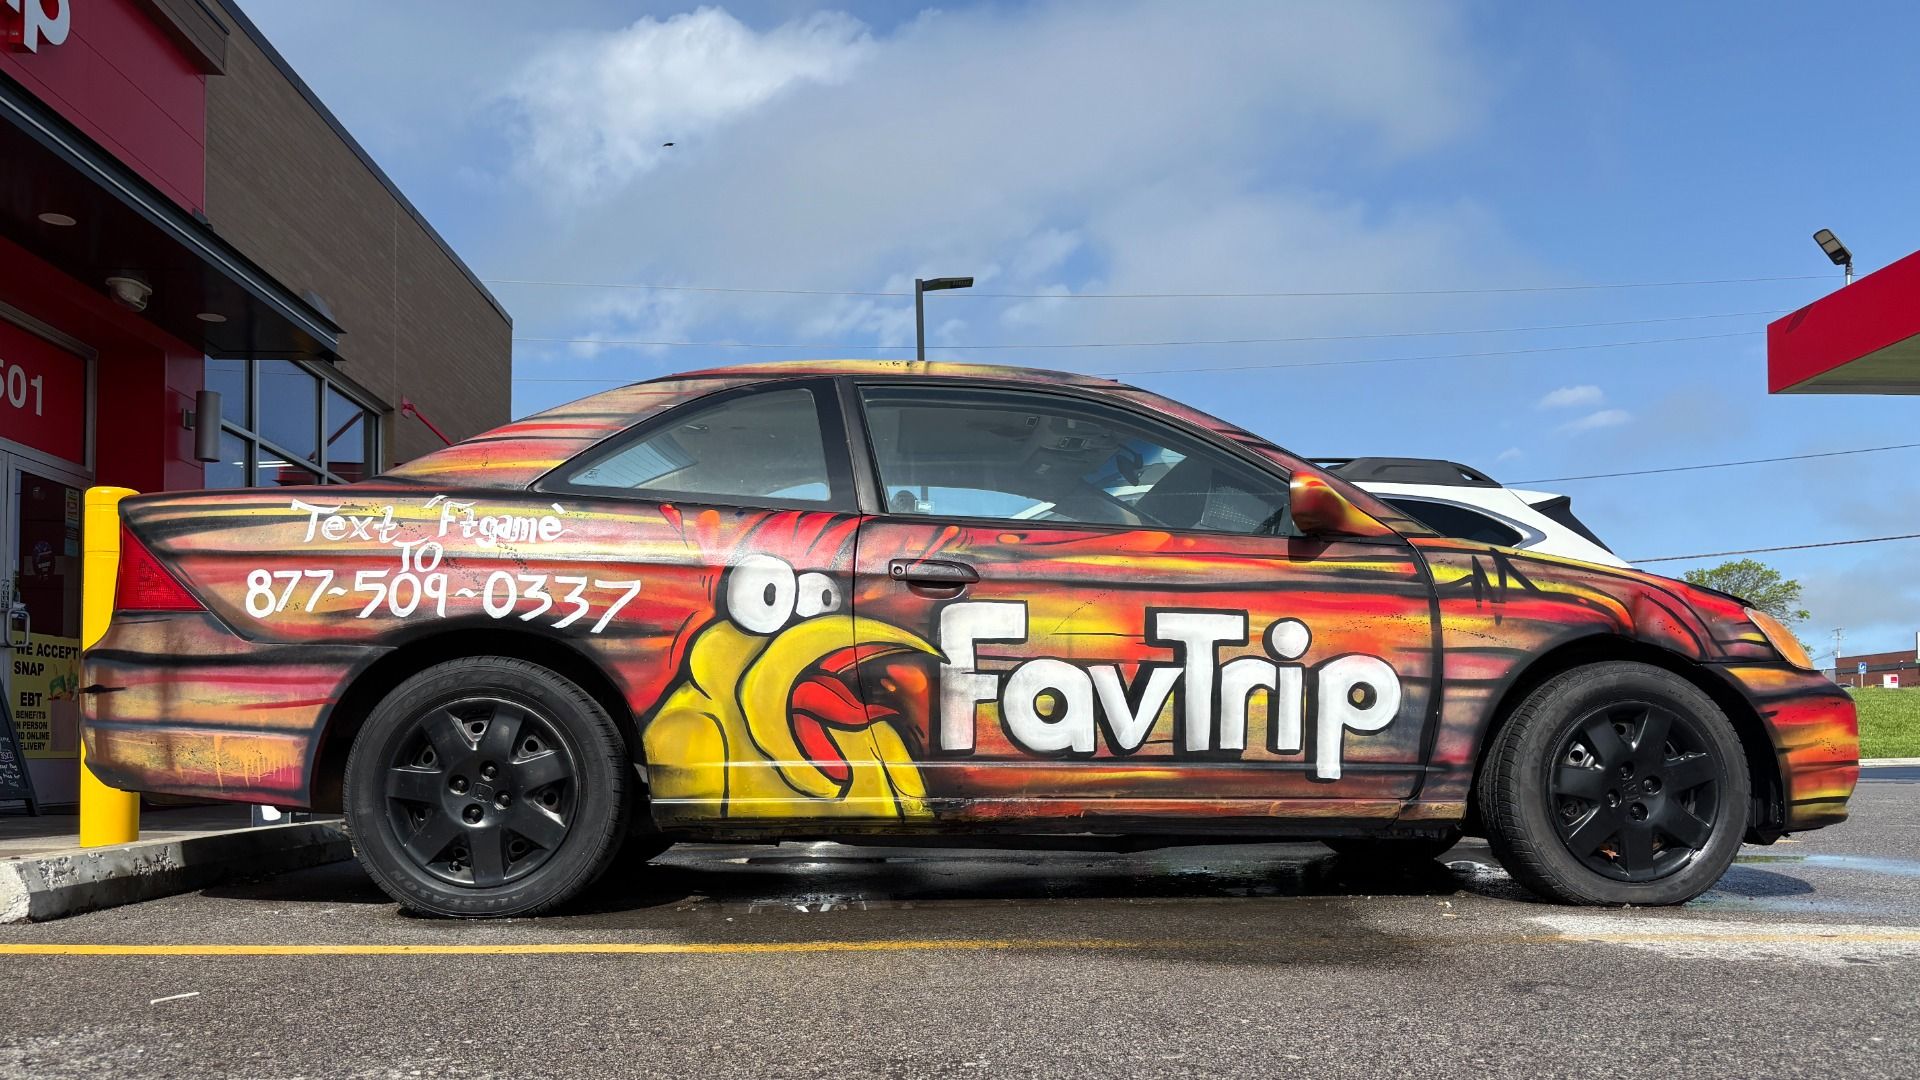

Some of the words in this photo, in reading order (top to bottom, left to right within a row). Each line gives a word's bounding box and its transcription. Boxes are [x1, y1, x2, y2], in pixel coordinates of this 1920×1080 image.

[6, 0, 71, 54] p
[290, 498, 401, 544] Text
[15, 640, 33, 656] WE
[36, 642, 79, 660] ACCEPT
[14, 660, 45, 677] SNAP
[20, 691, 43, 707] EBT
[938, 601, 1402, 781] FavTrip
[15, 710, 47, 720] BENEFITS
[22, 721, 48, 730] PERSON
[26, 731, 50, 741] ONLINE
[20, 741, 46, 751] ELIVERY
